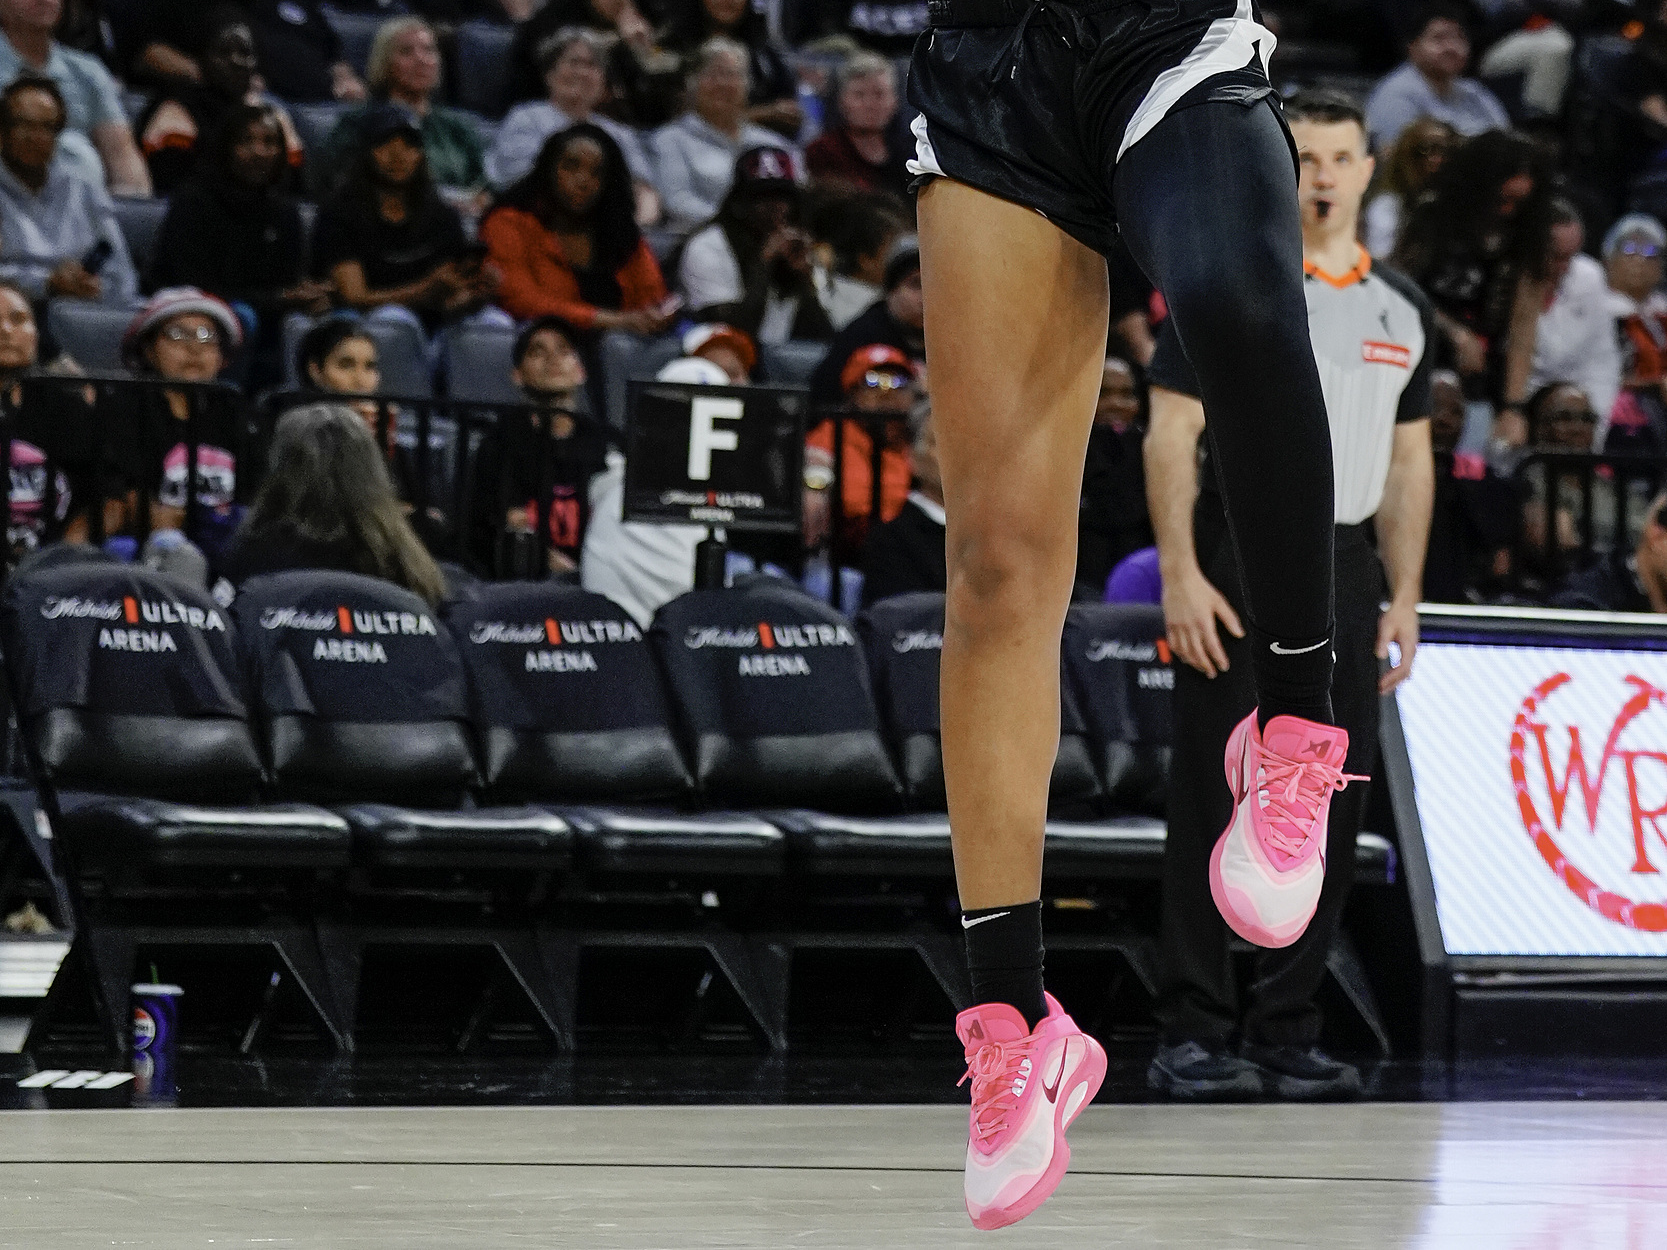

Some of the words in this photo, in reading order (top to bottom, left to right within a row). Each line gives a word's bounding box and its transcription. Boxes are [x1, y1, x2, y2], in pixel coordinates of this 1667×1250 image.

[687, 396, 745, 481] F
[141, 601, 226, 632] ULTRA
[353, 609, 437, 636] ULTRA
[99, 627, 178, 652] ARENA
[560, 619, 643, 643] ULTRA
[773, 623, 855, 647] ULTRA
[313, 636, 388, 664] ARENA
[525, 649, 598, 672] ARENA
[738, 653, 811, 677] ARENA
